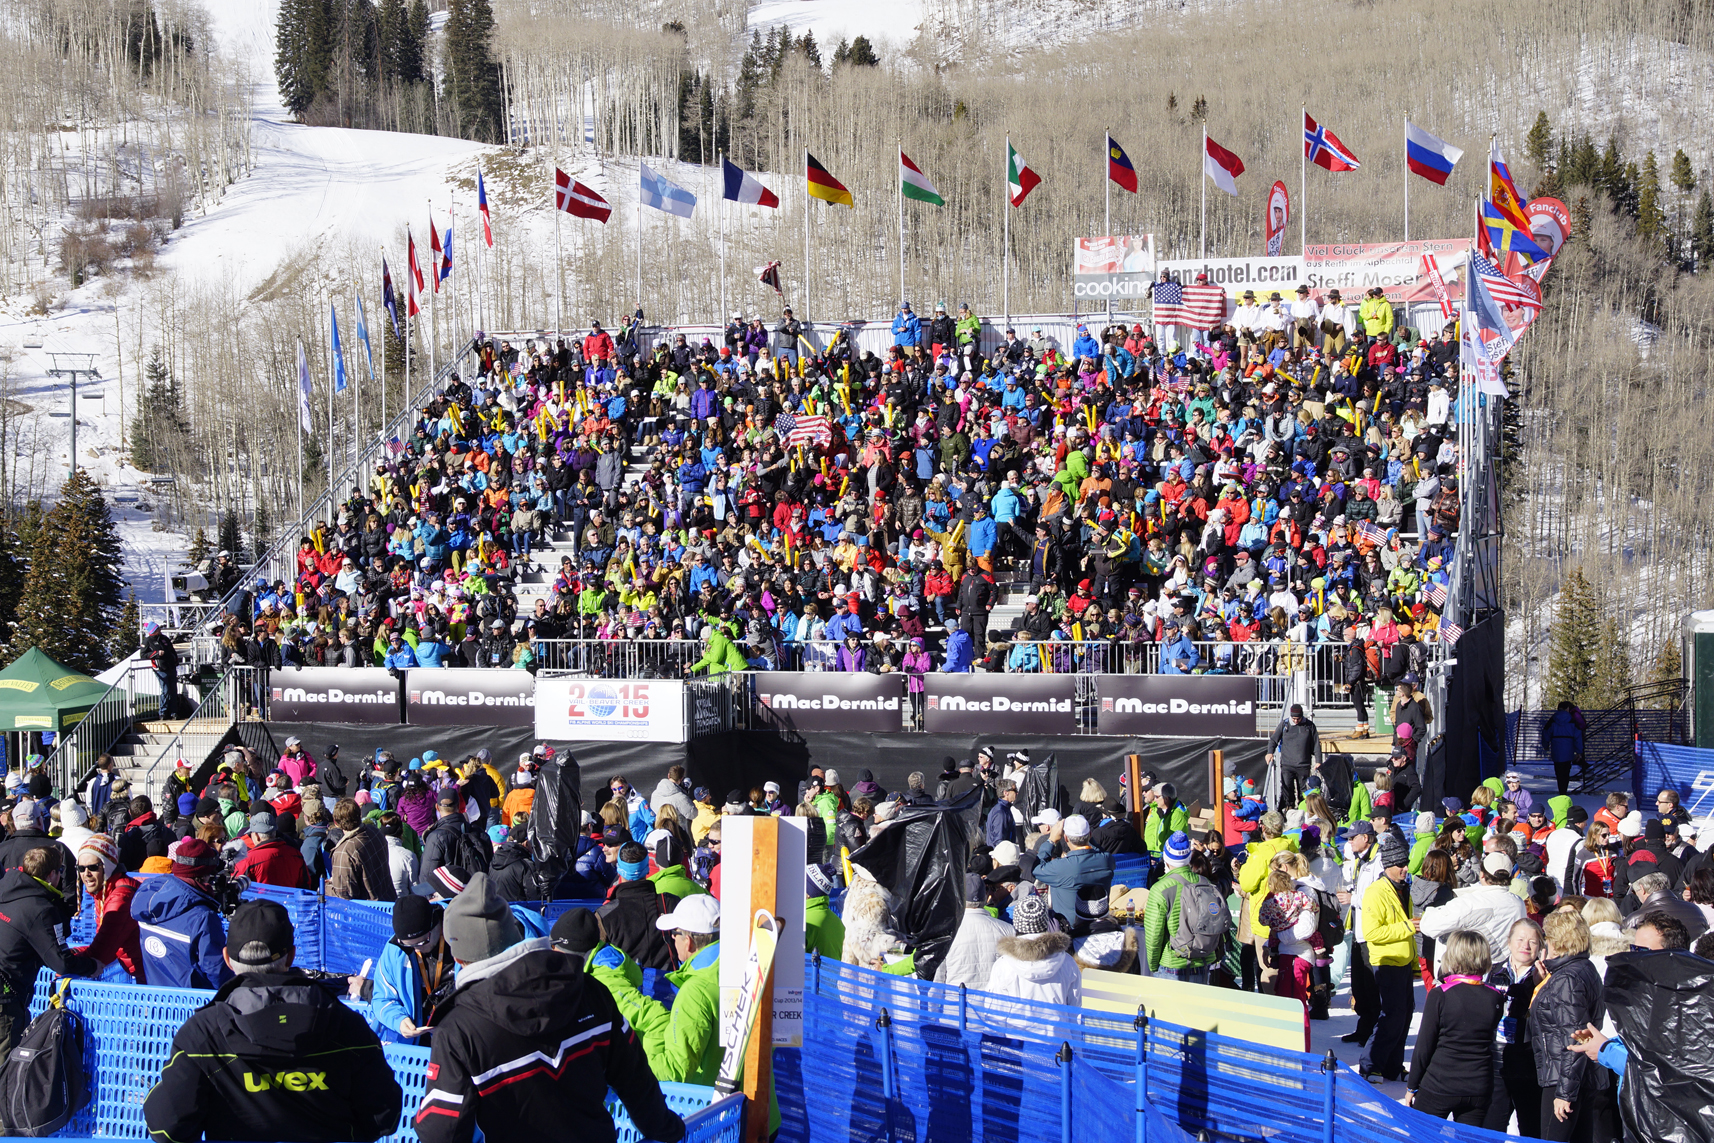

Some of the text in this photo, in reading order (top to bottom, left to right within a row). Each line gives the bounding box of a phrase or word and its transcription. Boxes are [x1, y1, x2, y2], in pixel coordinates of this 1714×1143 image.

[1529, 203, 1568, 225] Fanclub
[1307, 242, 1453, 256] Viel Glück unserem Stern
[1325, 259, 1348, 267] Reith
[1171, 263, 1297, 285] anzhotel.com
[1307, 272, 1423, 289] Steffi Moser
[284, 688, 396, 704] MacDermid
[772, 694, 898, 710] MacDermid
[940, 696, 1071, 712] MacDermid
[1115, 698, 1252, 714] MacDermid
[724, 1010, 734, 1018] VA
[779, 1011, 802, 1019] CREEK
[720, 972, 751, 1077] ISCHER
[243, 1071, 330, 1092] uvex
